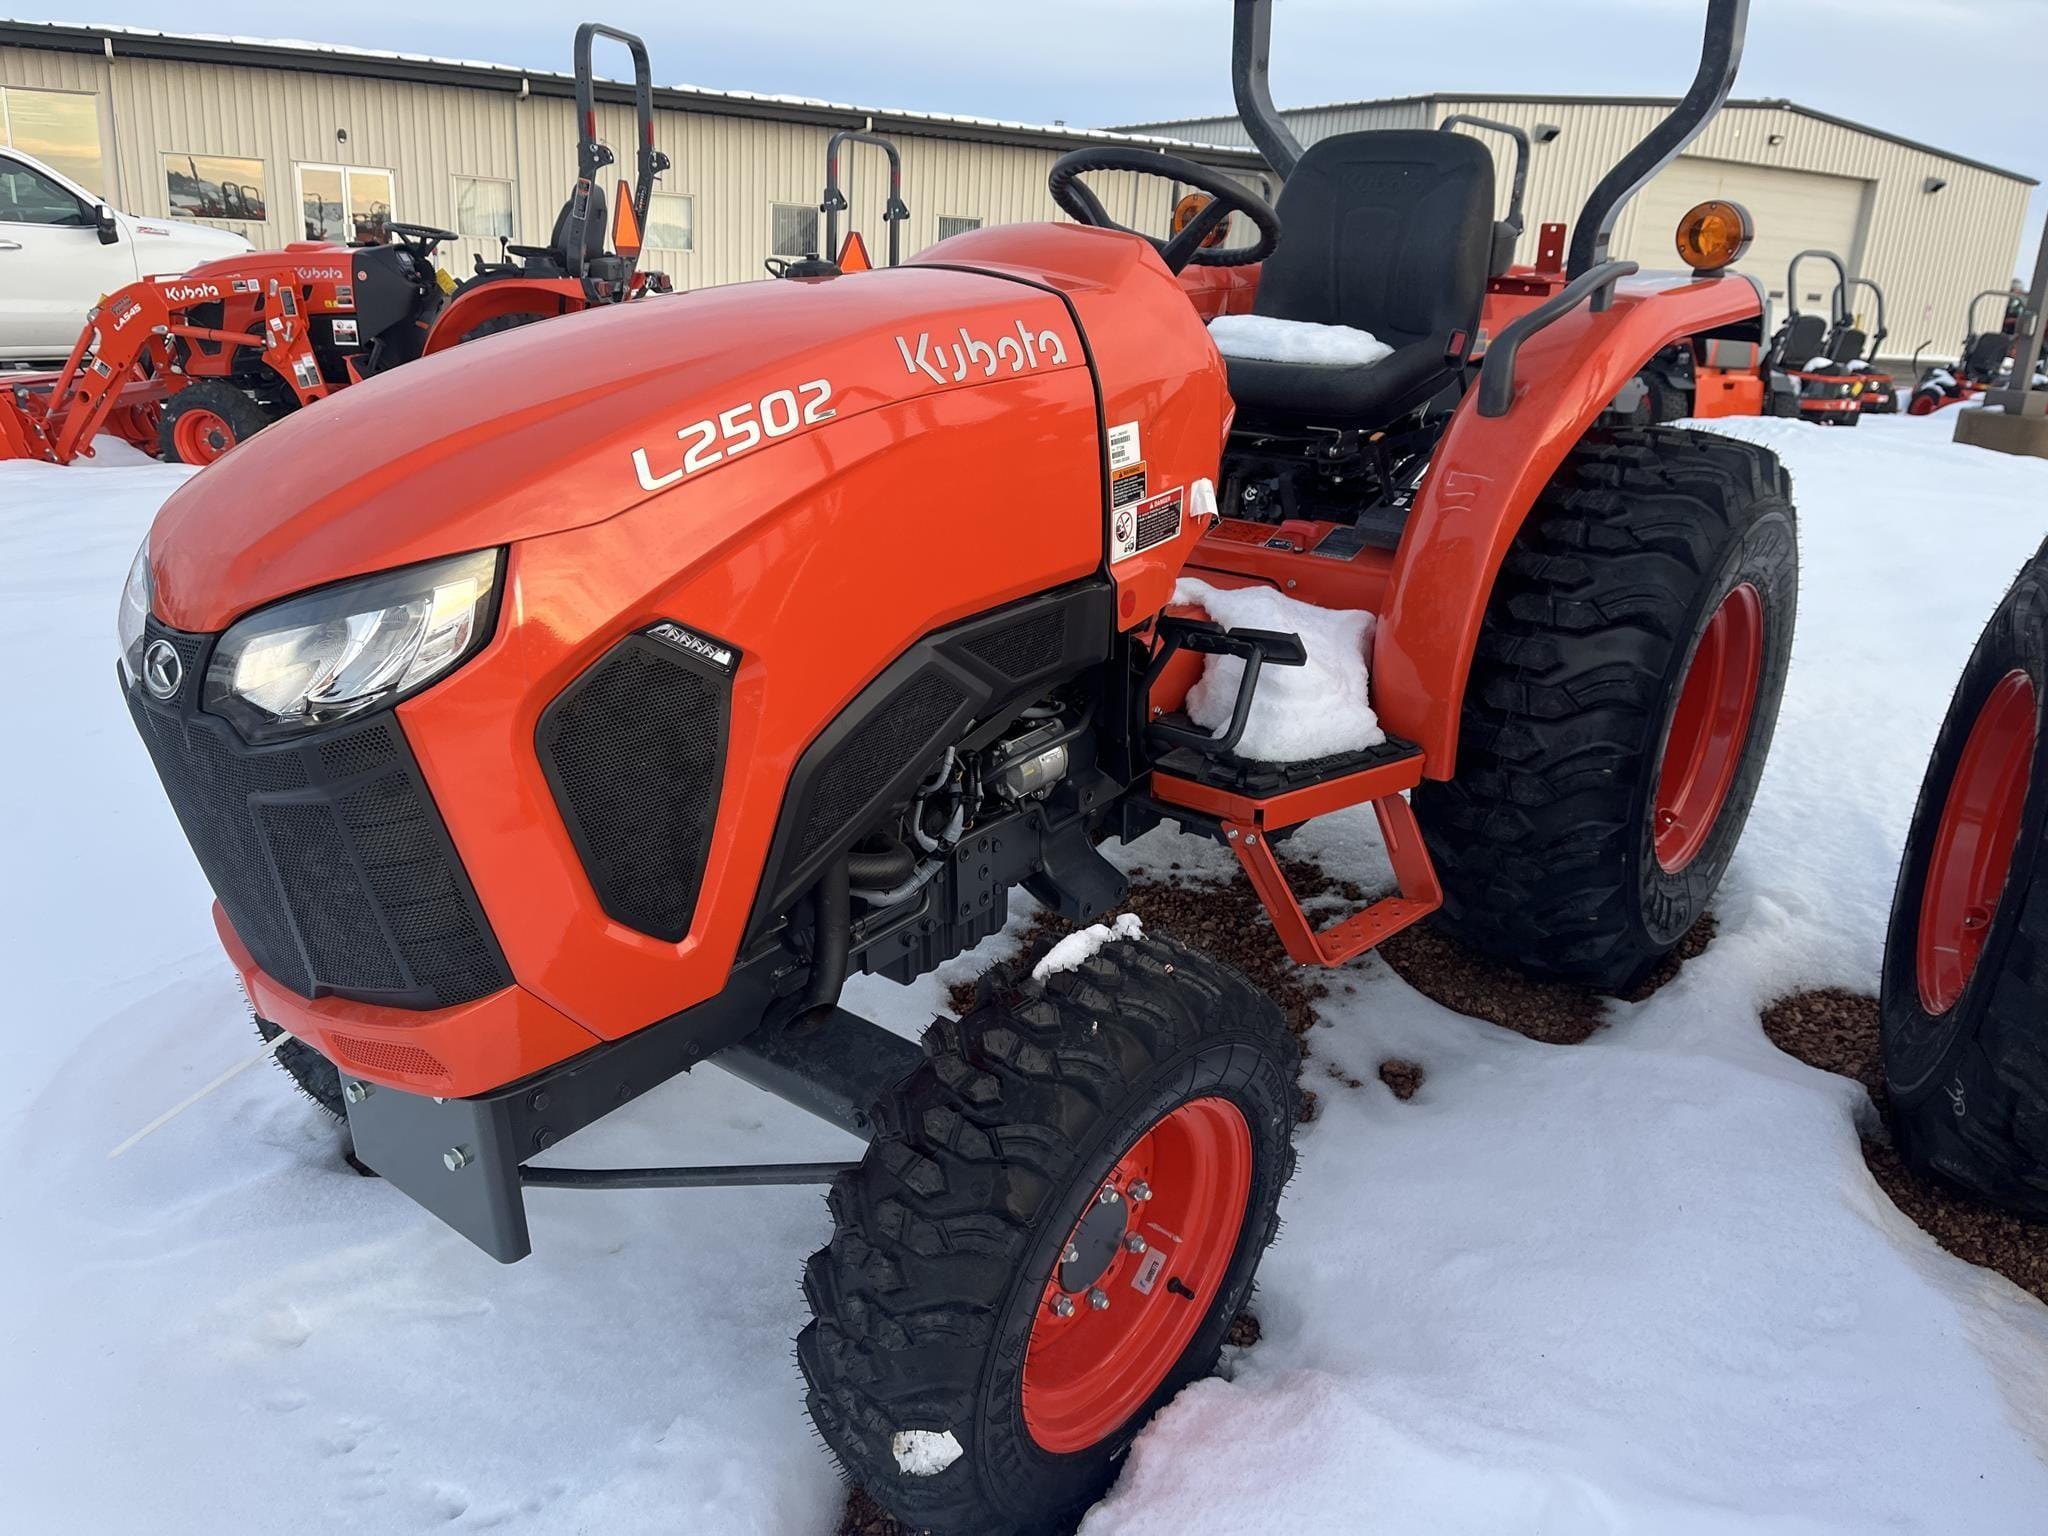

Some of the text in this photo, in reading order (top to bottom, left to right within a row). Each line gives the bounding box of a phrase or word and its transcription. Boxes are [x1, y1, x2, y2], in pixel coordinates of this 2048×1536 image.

[294, 266, 343, 279] Kubota
[165, 283, 219, 301] Kubota
[113, 303, 142, 331] LA545
[895, 319, 1068, 384] Kubota
[631, 378, 838, 492] L2502
[1153, 495, 1171, 508] DANGER
